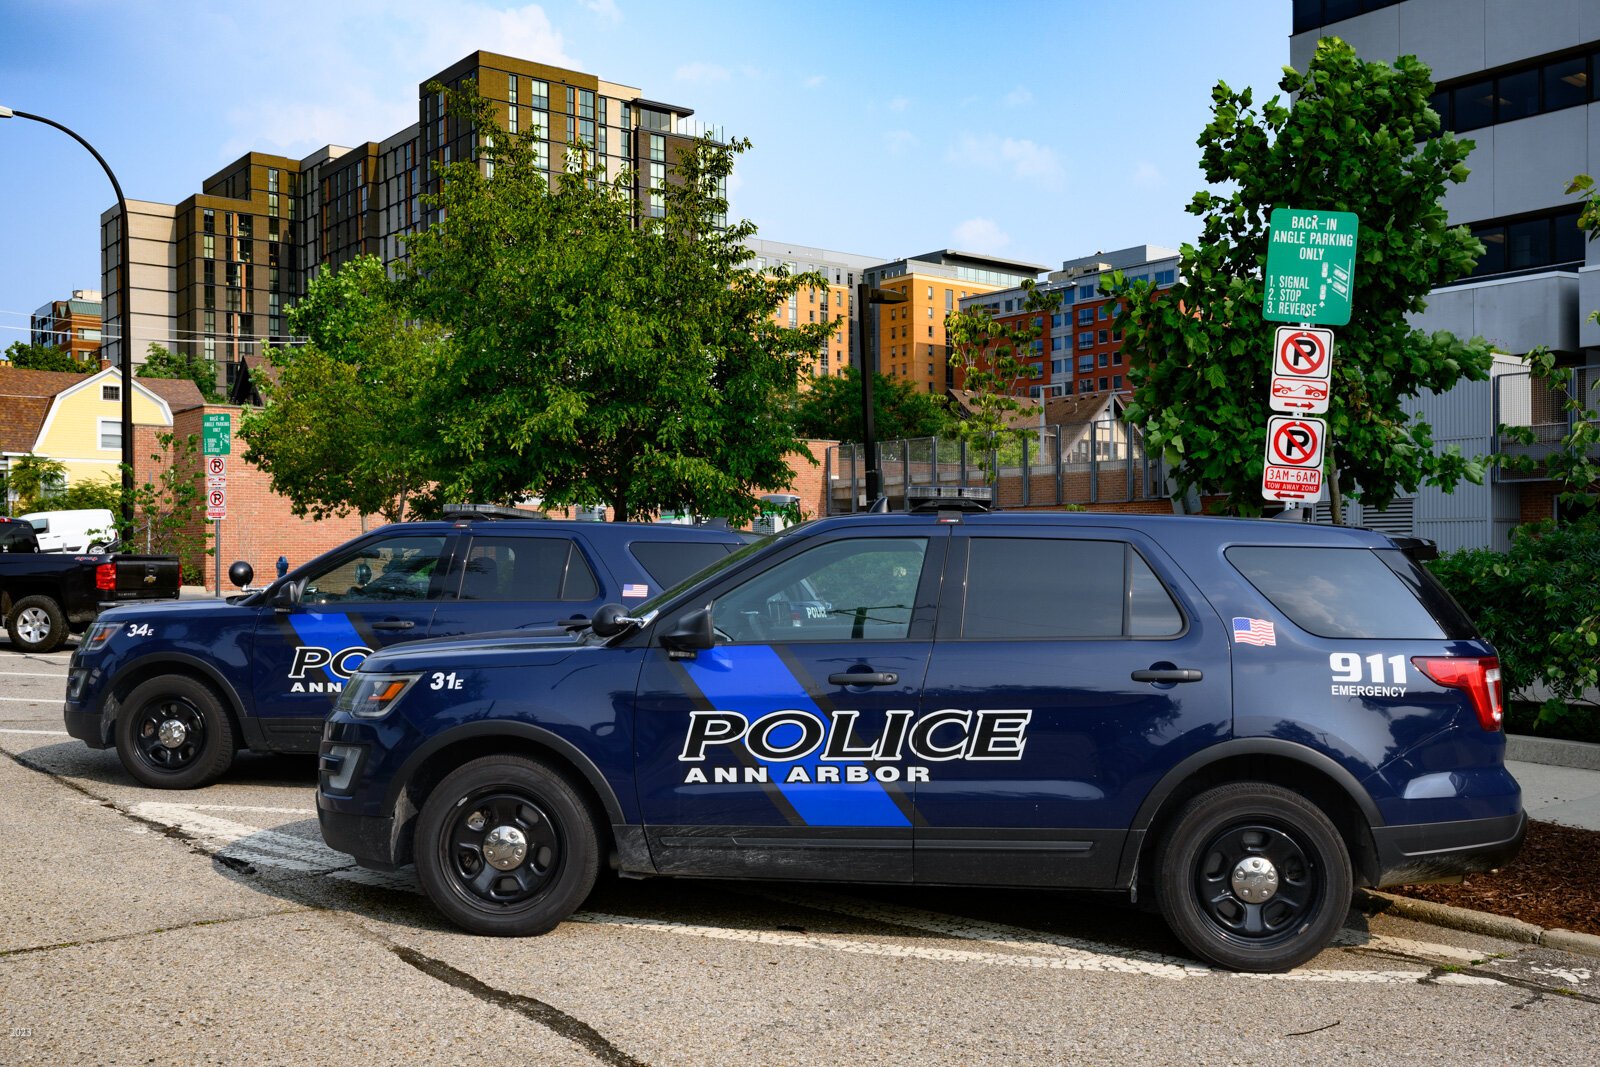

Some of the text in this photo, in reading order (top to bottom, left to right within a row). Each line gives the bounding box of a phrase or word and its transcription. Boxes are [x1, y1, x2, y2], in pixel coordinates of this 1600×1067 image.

[1292, 215, 1337, 231] BACK-IN
[1273, 230, 1353, 247] ANGLE PARKING
[1299, 247, 1324, 260] ONLY
[1270, 275, 1310, 289] 1. SIGNAL
[1268, 288, 1301, 302] 2. STOP
[1267, 301, 1317, 316] 3. REVERSE
[1269, 469, 1317, 483] 3AM-6AM
[1329, 652, 1407, 684] 911
[290, 682, 342, 692] ANN
[1331, 685, 1407, 697] EMERGENCY
[678, 709, 1032, 762] POLICE
[684, 766, 930, 783] ANN ARBOR
